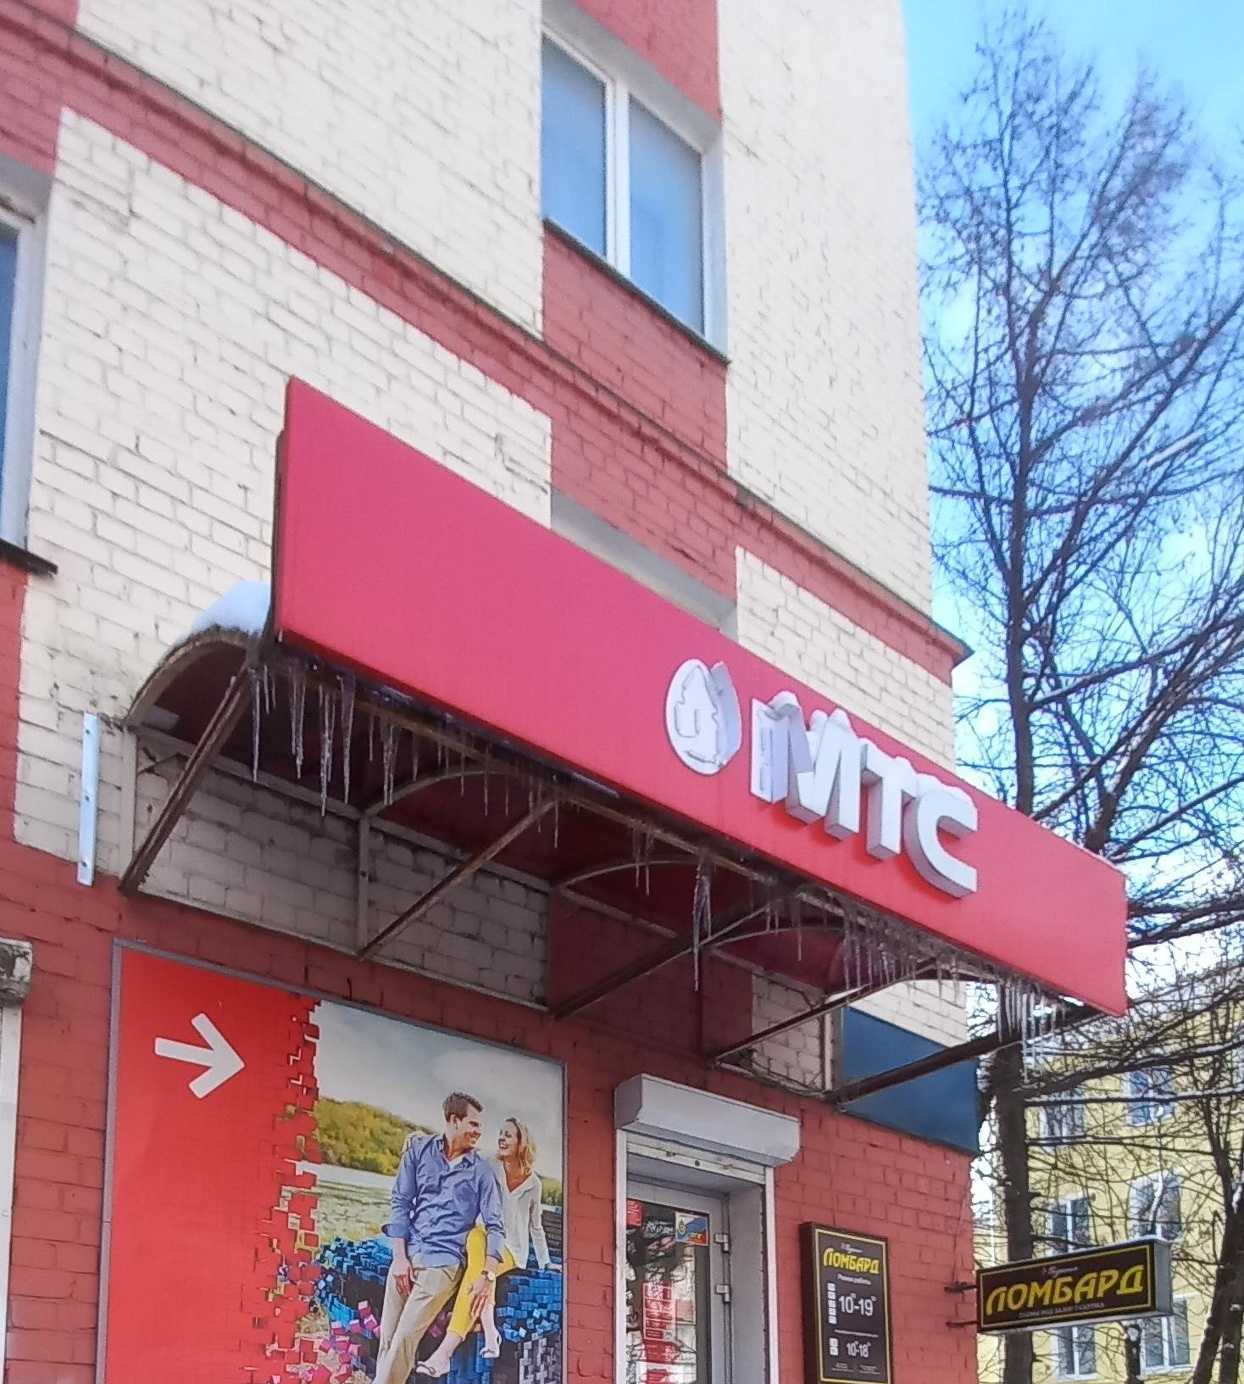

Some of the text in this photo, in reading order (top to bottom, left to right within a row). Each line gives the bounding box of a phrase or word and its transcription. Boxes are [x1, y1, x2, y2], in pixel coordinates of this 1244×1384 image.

[751, 689, 978, 898] МТС
[823, 1247, 880, 1274] ЛОМБАРД
[985, 1264, 1145, 1316] ЛОМБАРД
